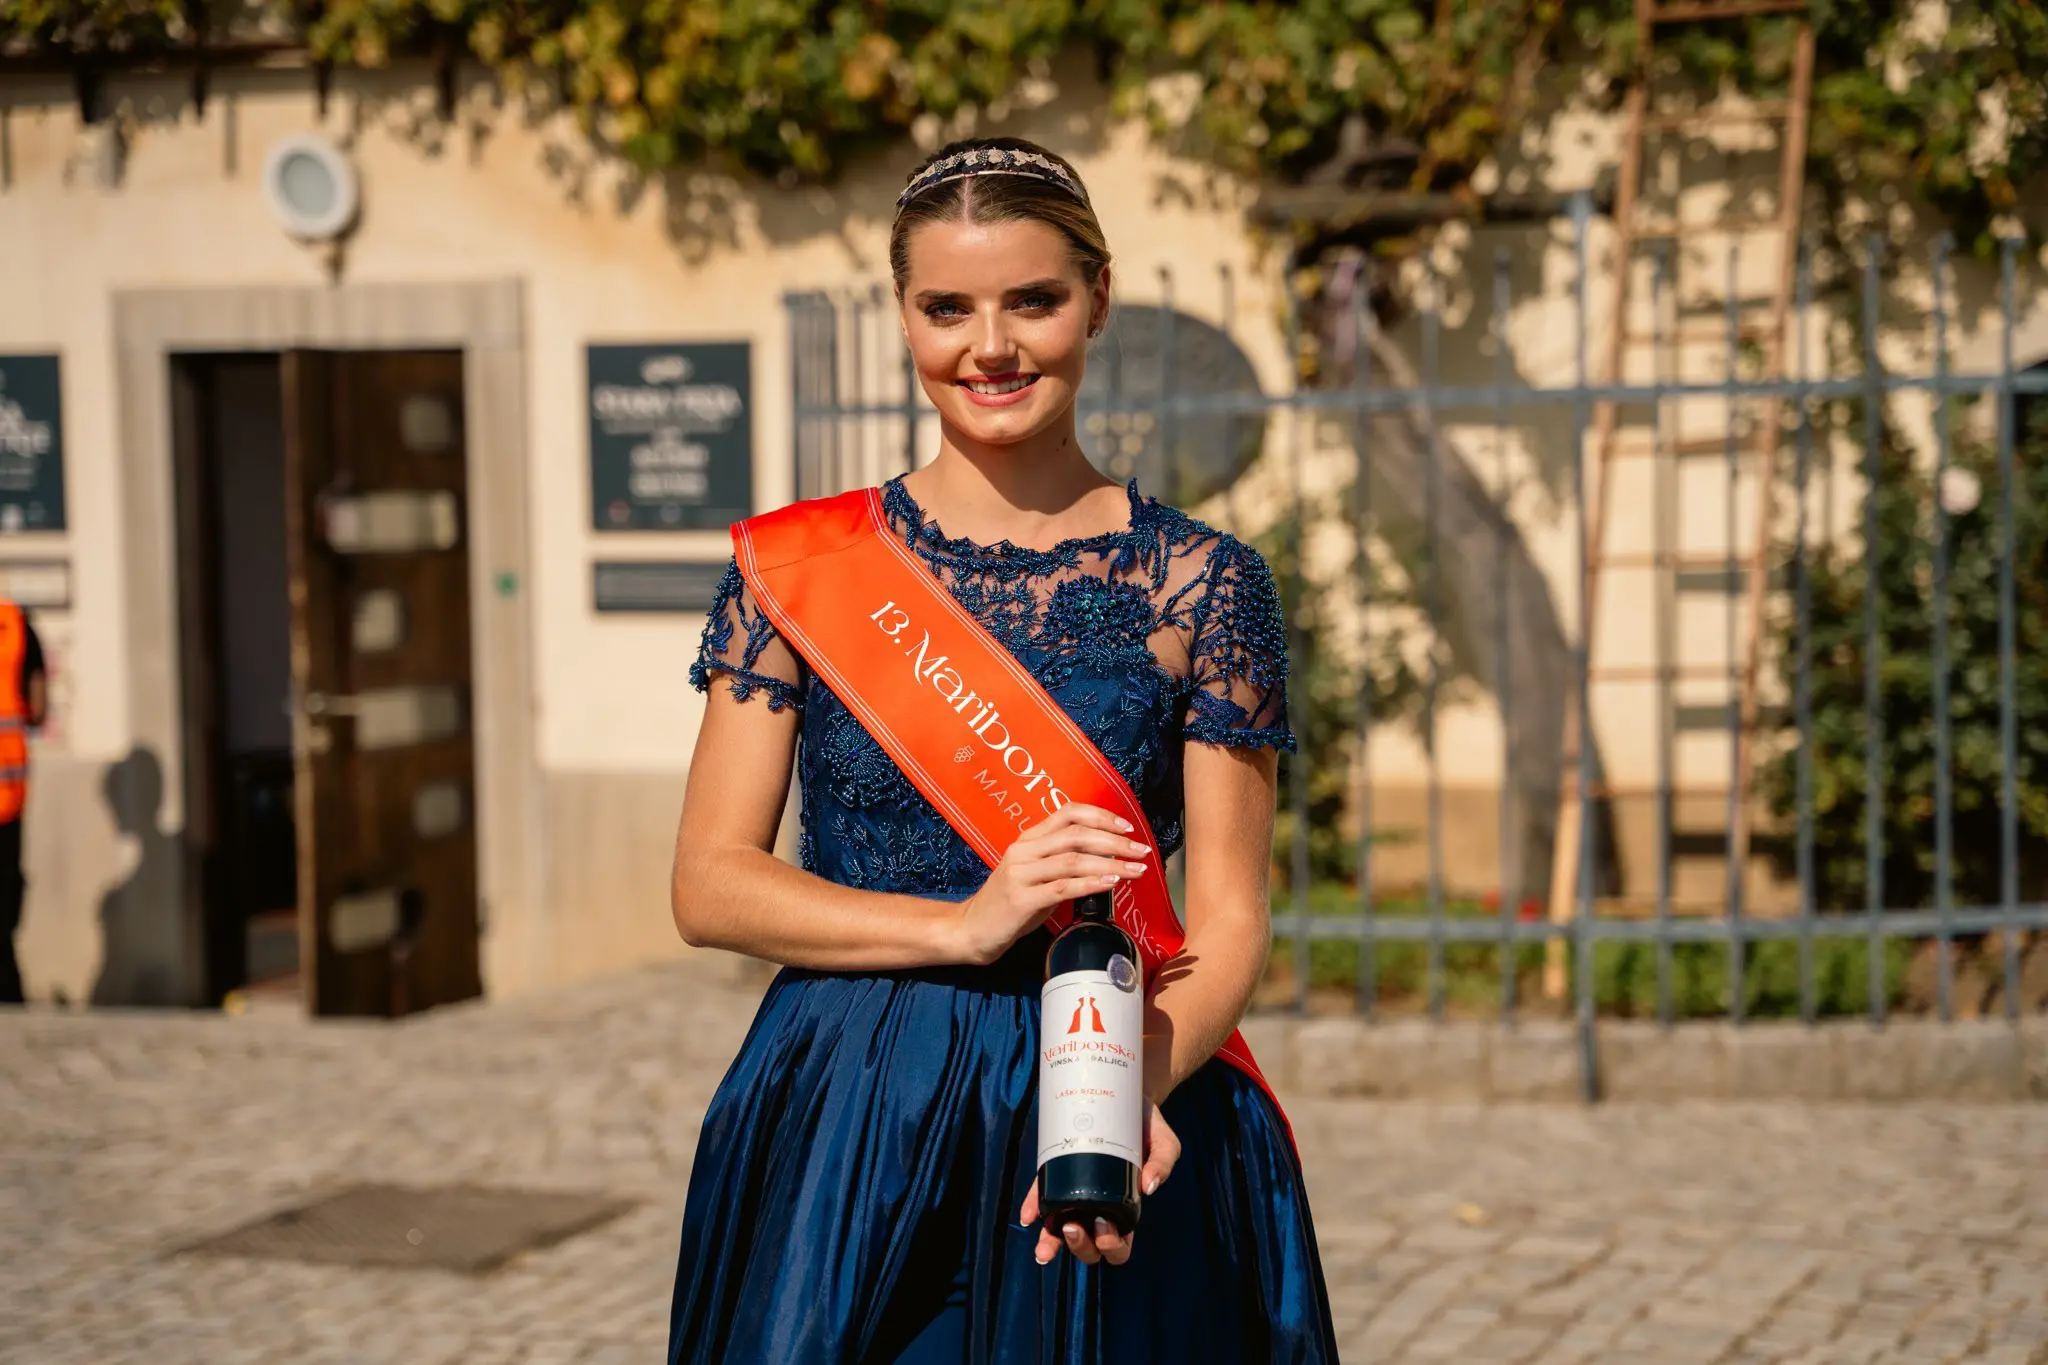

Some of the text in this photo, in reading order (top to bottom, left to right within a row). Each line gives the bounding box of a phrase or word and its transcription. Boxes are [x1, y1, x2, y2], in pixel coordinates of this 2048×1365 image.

[869, 600, 910, 644] 13.
[904, 627, 1072, 816] Maribors
[1086, 1055, 1128, 1068] RALJICA
[1080, 1088, 1116, 1098] RIZLING
